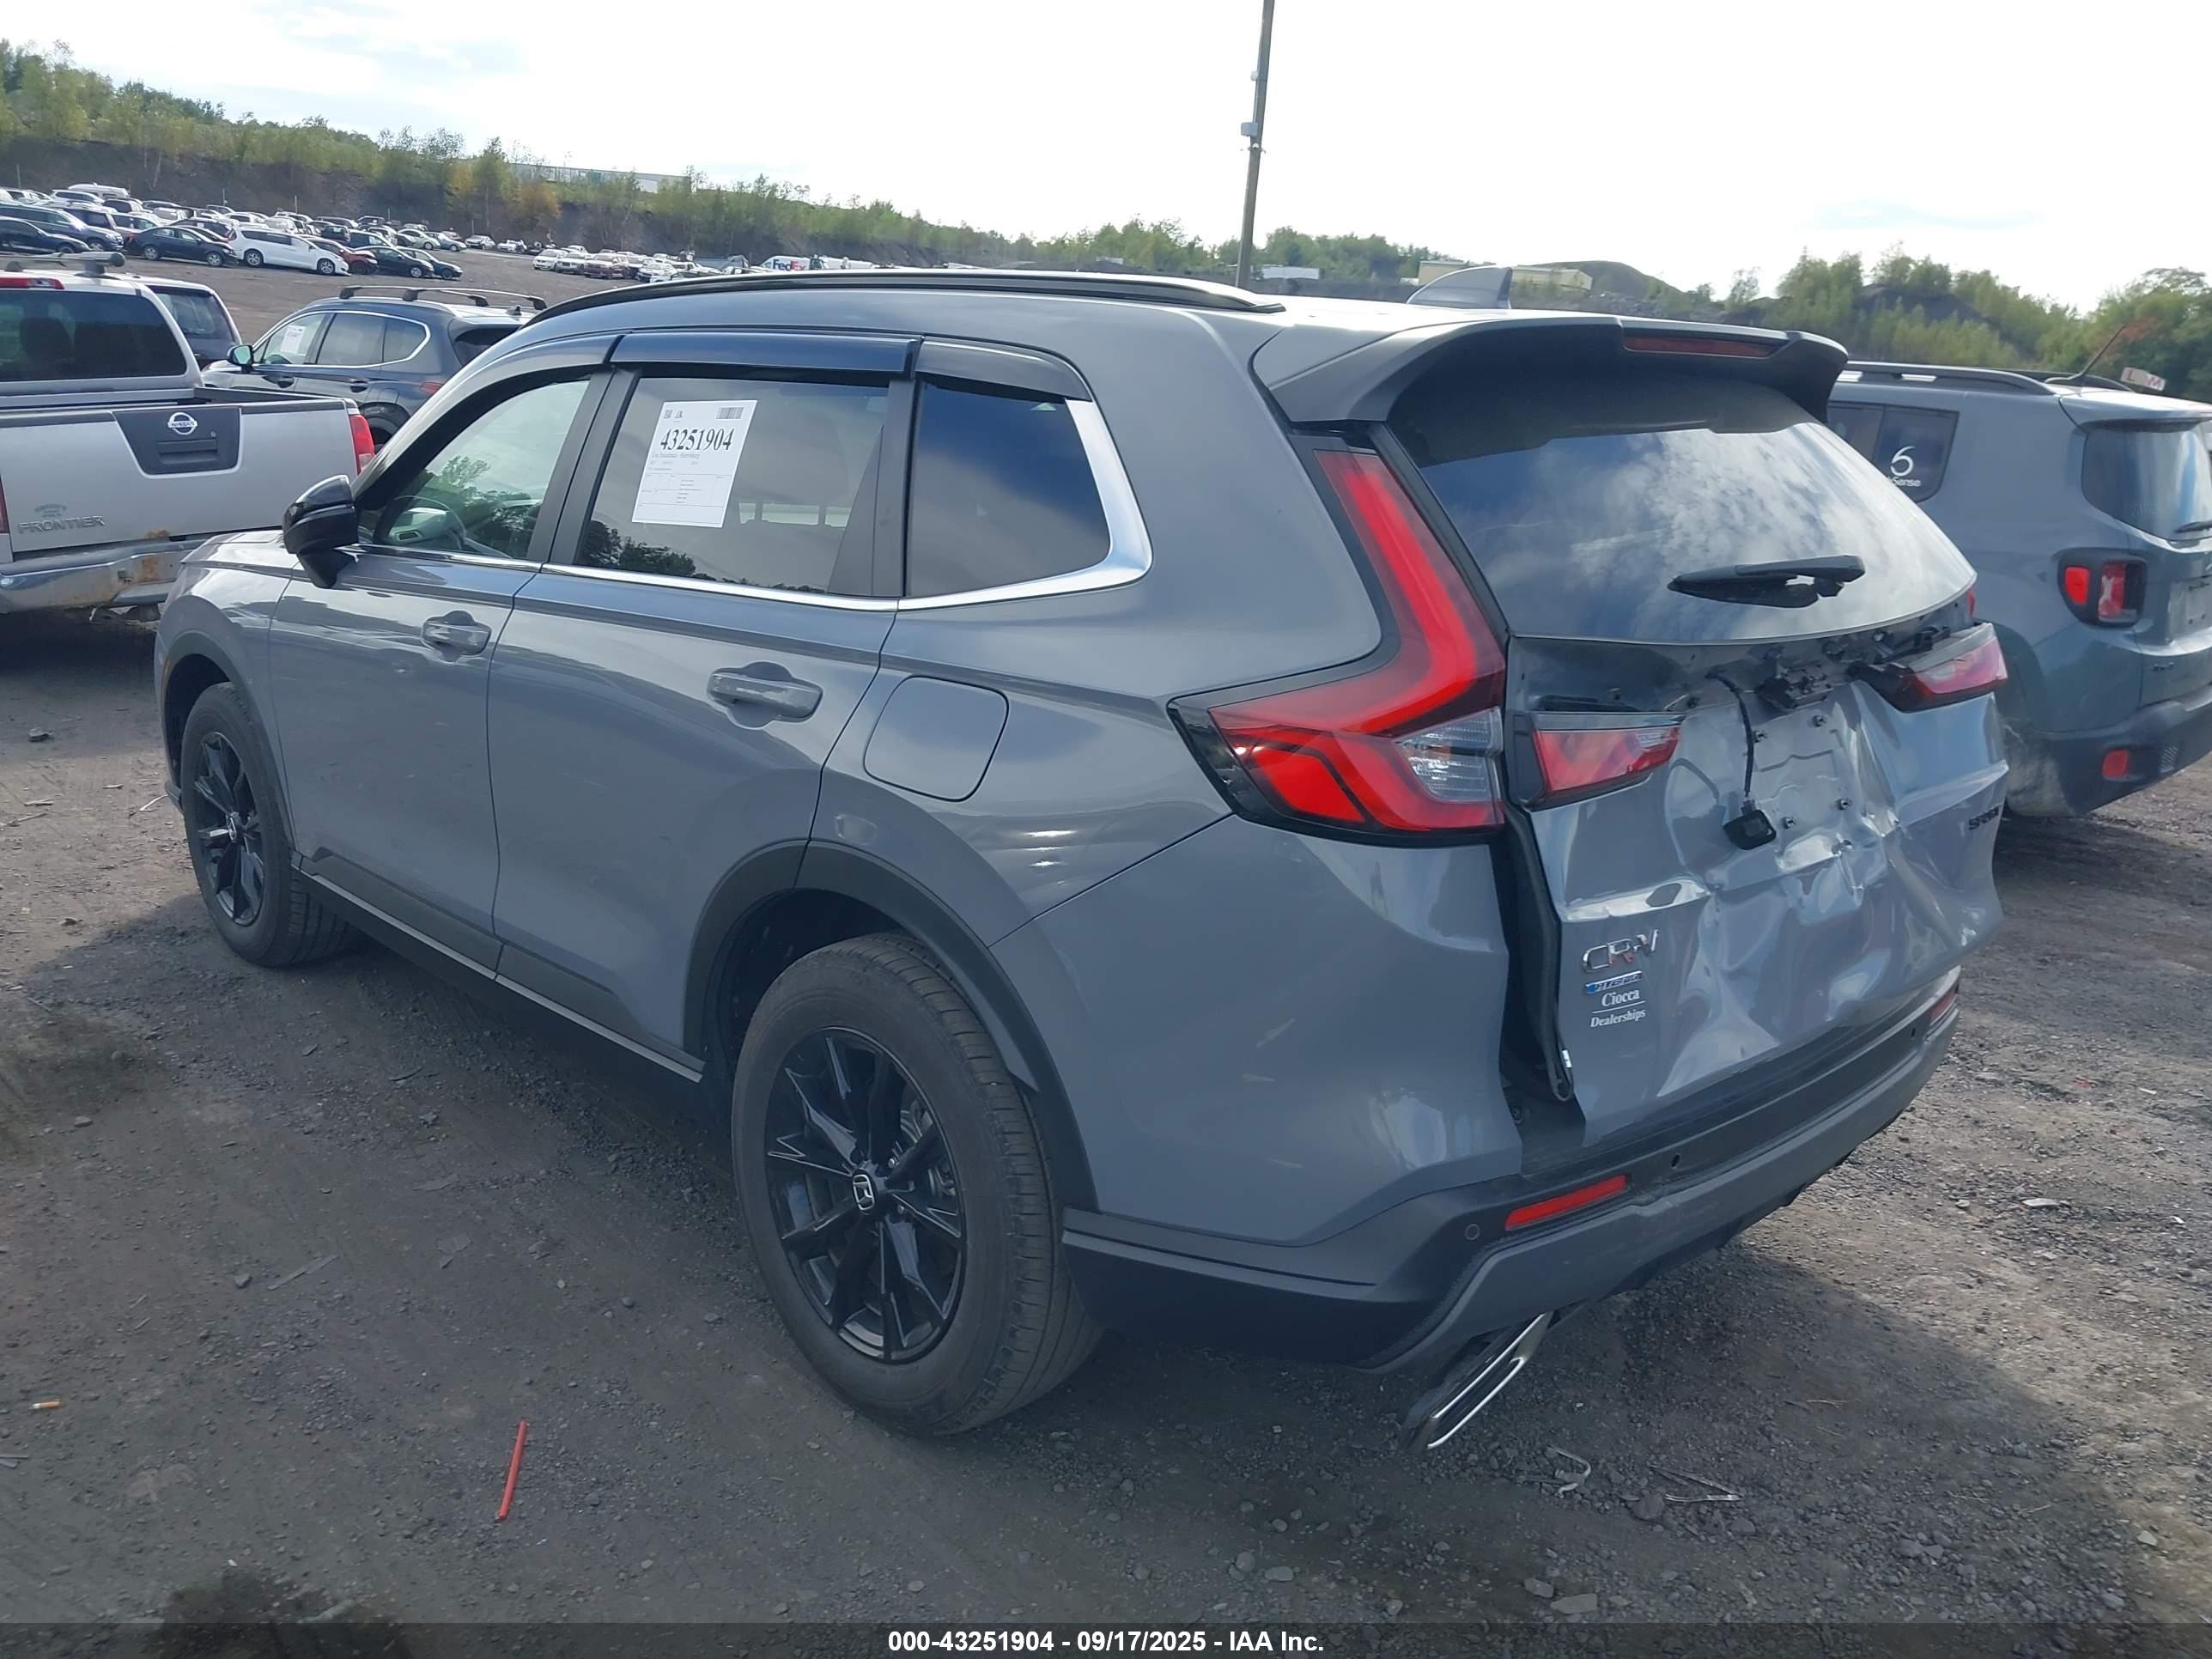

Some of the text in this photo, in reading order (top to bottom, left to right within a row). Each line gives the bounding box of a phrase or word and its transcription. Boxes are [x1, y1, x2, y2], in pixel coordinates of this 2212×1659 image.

[659, 428, 735, 451] 43251904
[18, 515, 106, 534] FRONTIER
[1601, 989, 1640, 1007] Ciocca
[1590, 1009, 1646, 1028] Dealerships
